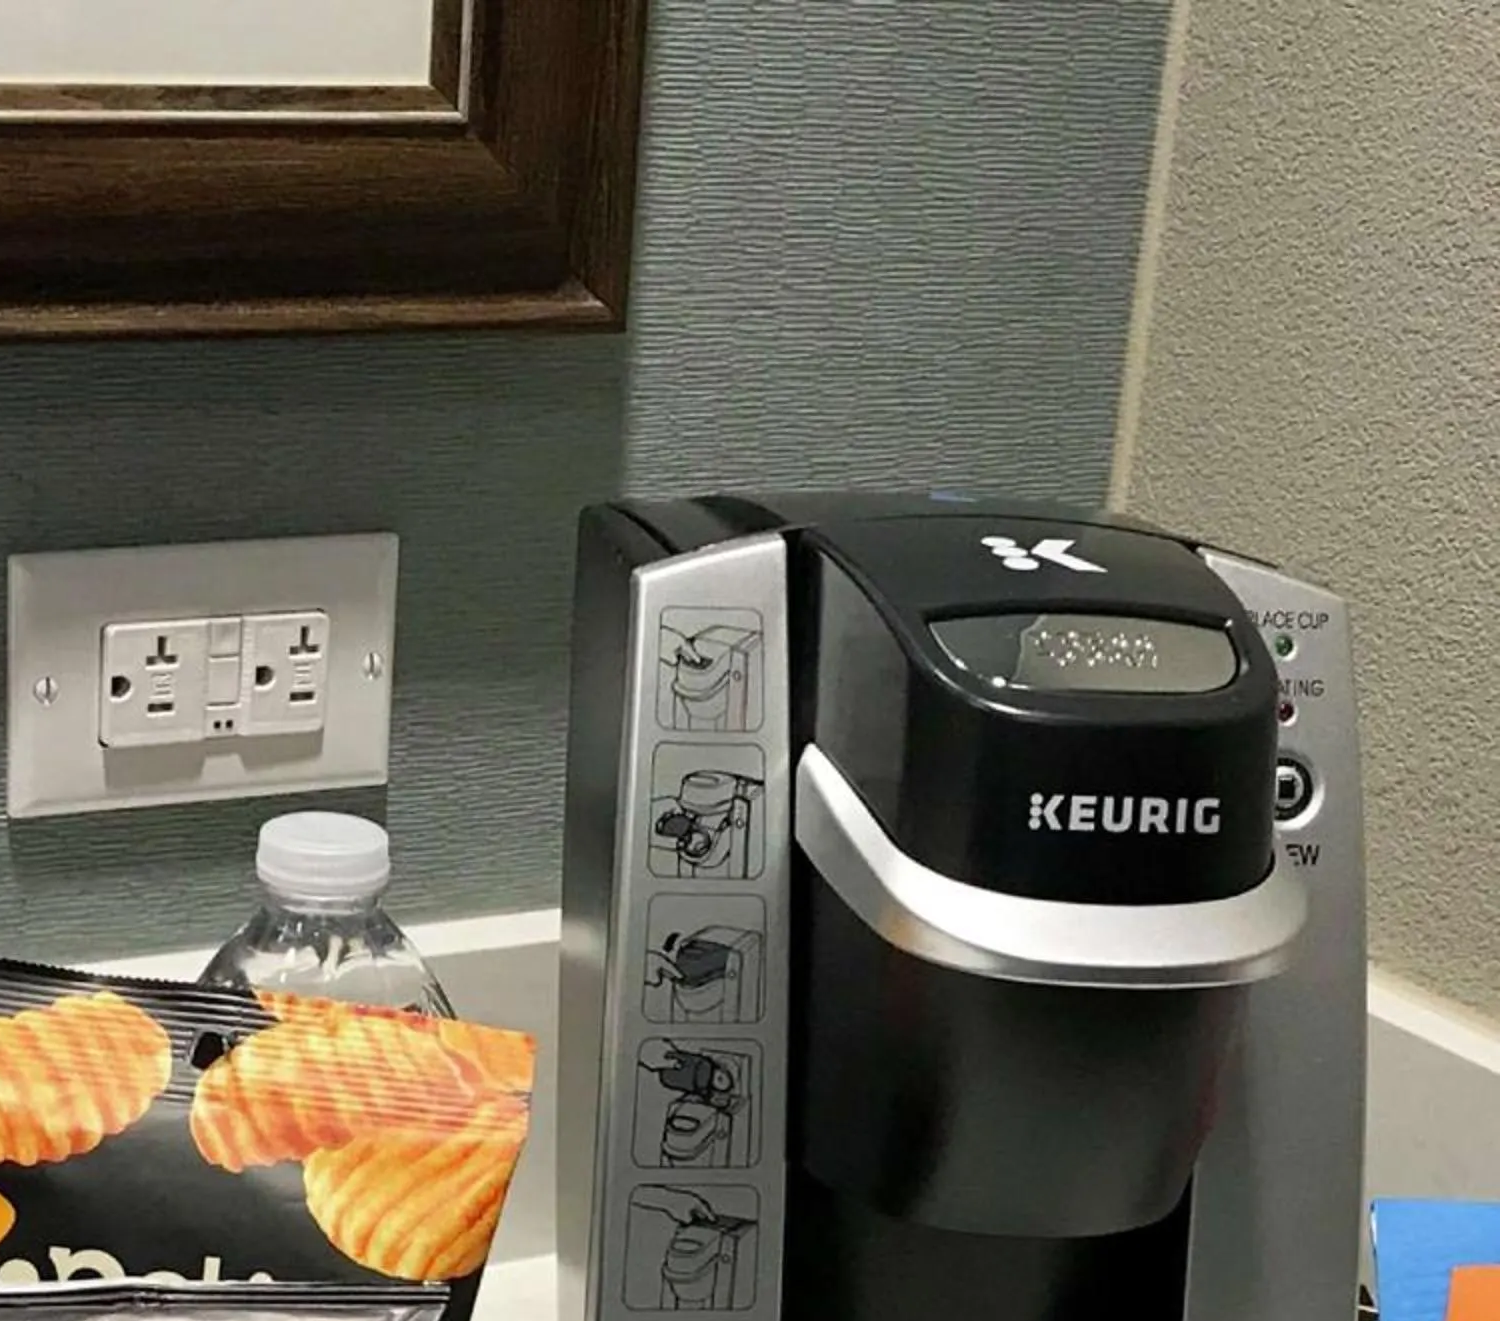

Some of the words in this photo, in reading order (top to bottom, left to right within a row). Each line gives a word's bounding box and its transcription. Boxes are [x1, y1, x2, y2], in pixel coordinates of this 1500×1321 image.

[1298, 609, 1329, 629] CUP
[1277, 679, 1325, 698] ATING
[1028, 792, 1221, 834] KEURIG
